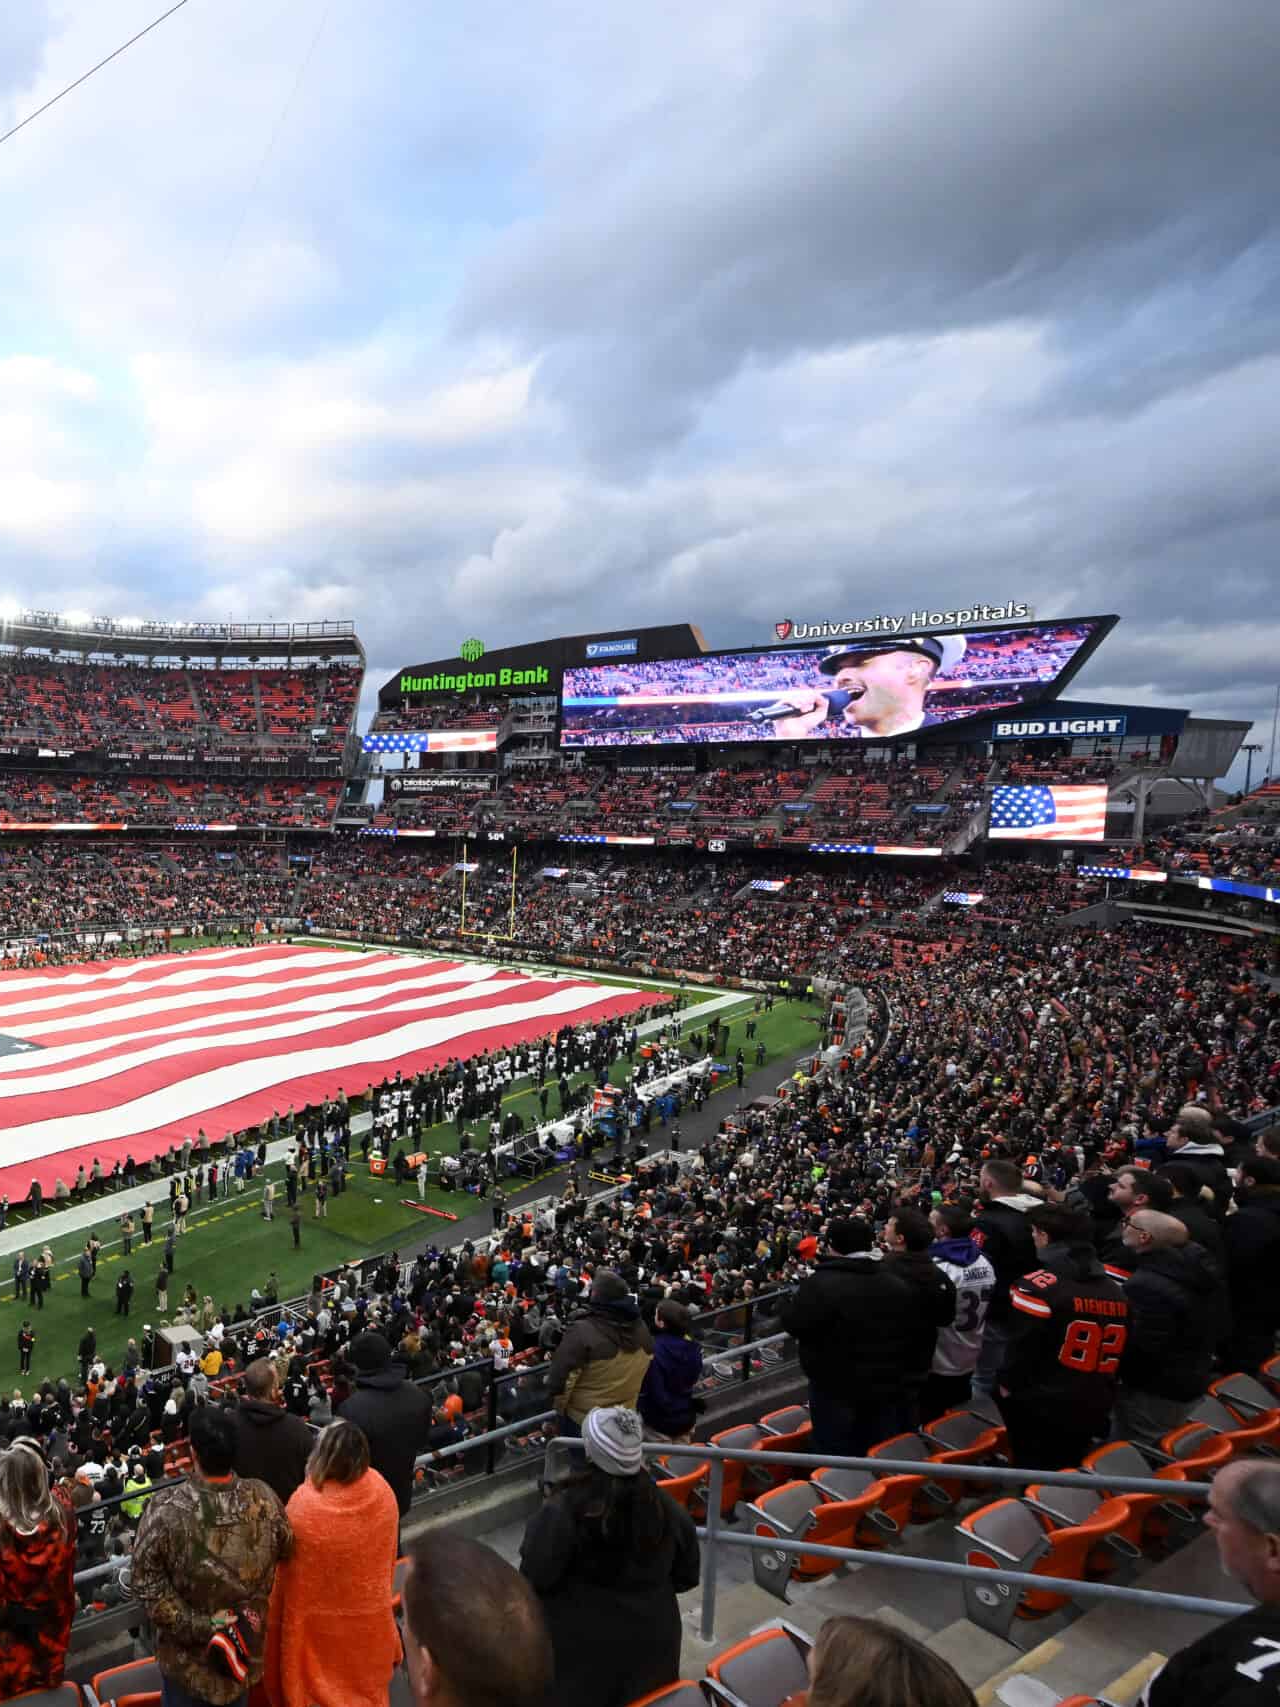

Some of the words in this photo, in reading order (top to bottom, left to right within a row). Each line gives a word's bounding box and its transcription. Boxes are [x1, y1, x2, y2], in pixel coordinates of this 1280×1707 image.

[792, 615, 905, 639] University
[911, 600, 1028, 627] Hospitals
[400, 672, 497, 693] Huntington
[499, 665, 549, 686] Bank
[996, 722, 1046, 736] BUD
[1048, 719, 1121, 734] LIGHT
[1058, 1319, 1128, 1374] 82
[89, 1520, 106, 1534] 73
